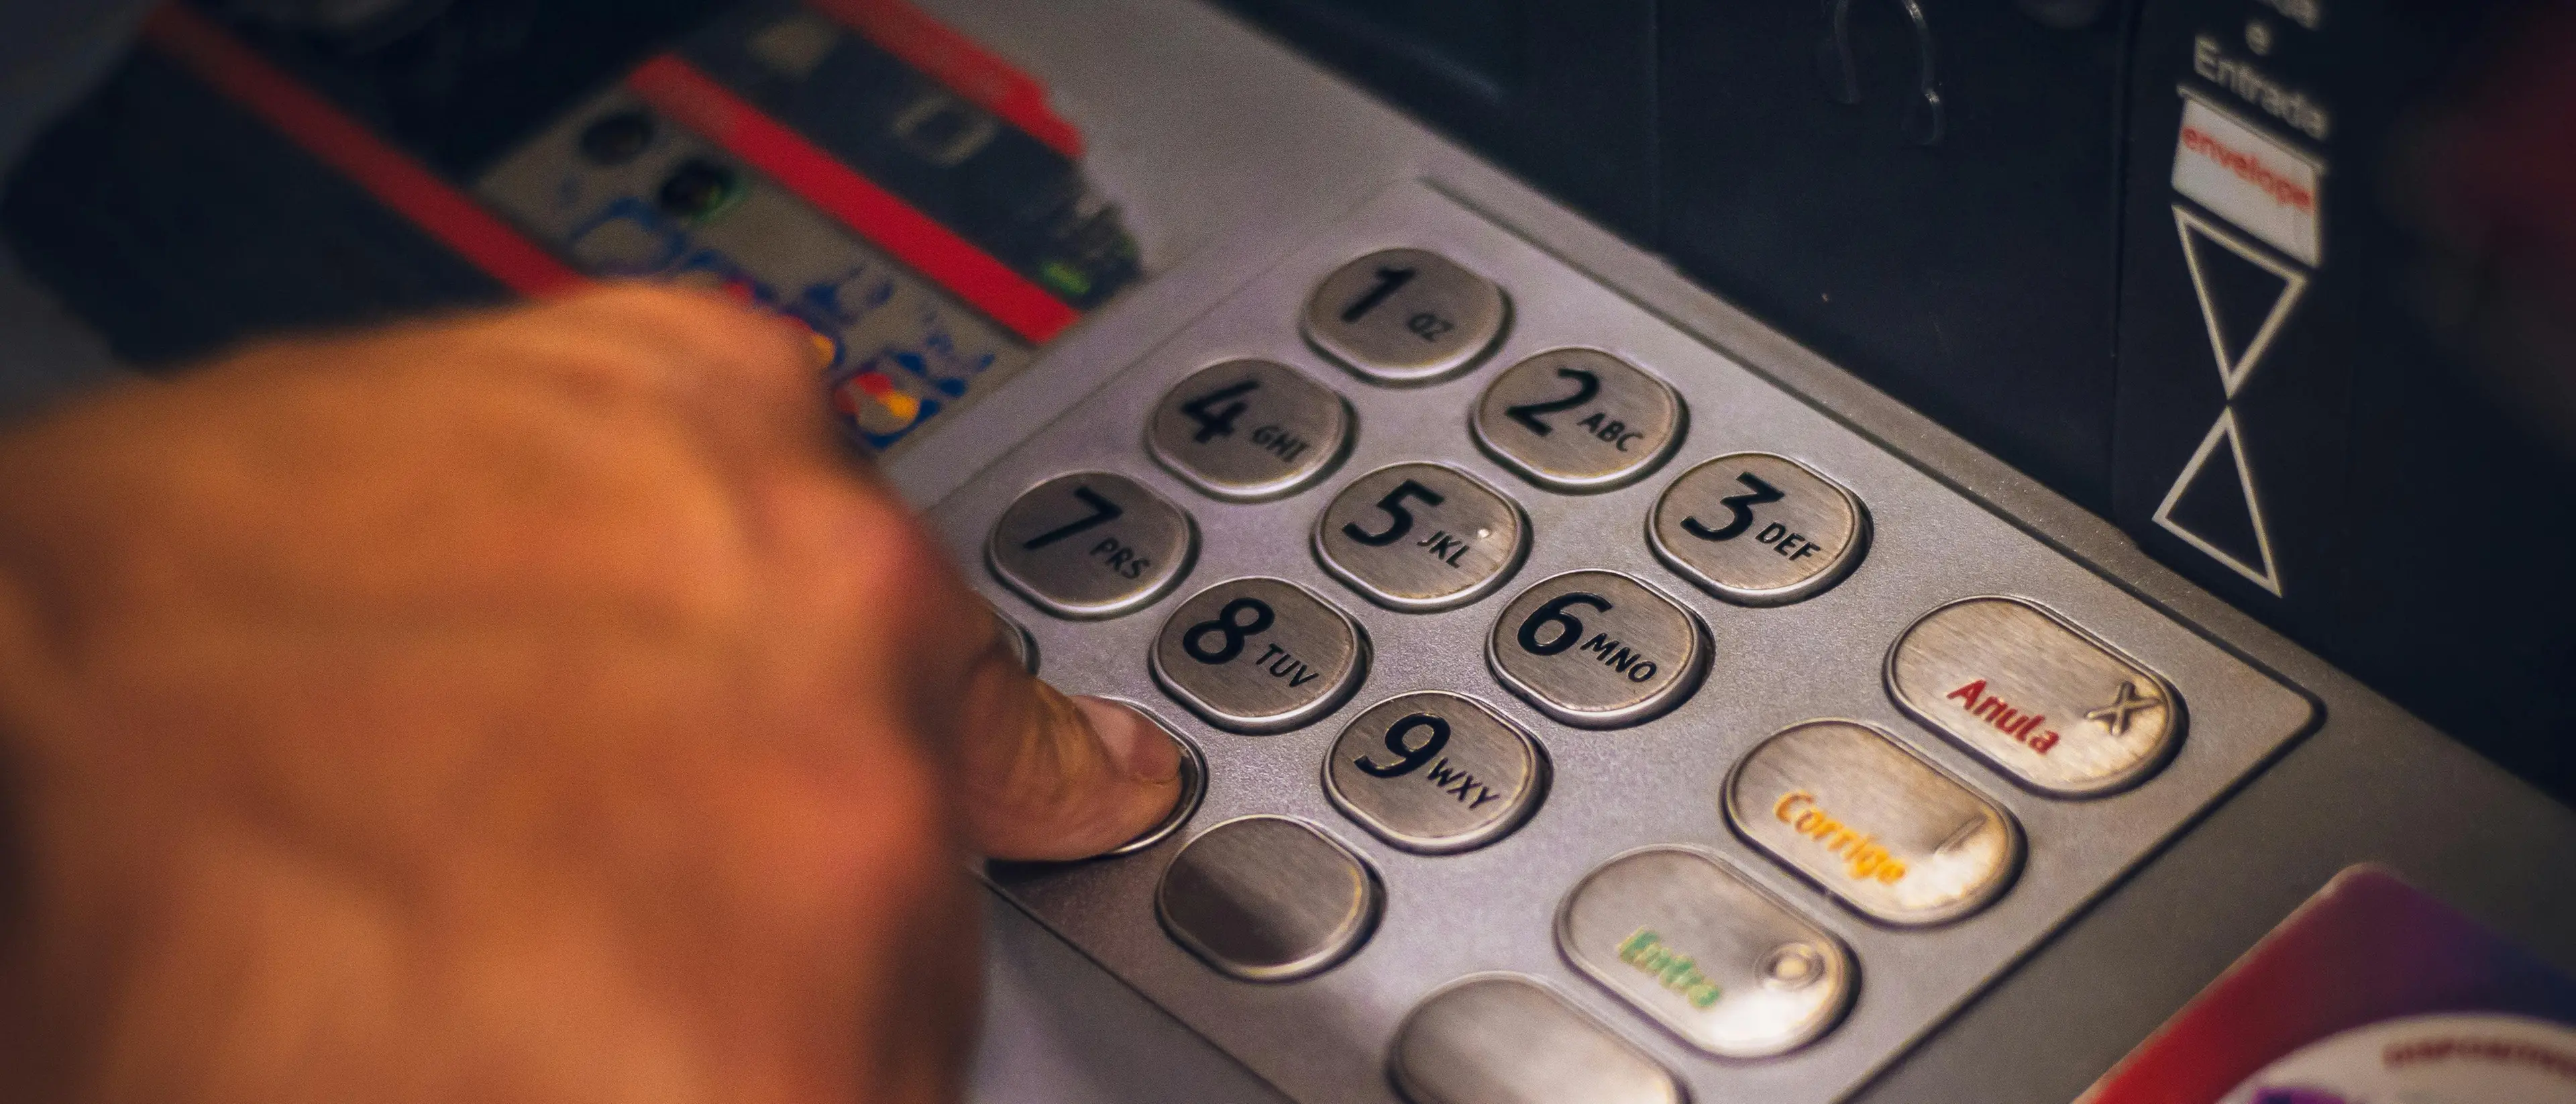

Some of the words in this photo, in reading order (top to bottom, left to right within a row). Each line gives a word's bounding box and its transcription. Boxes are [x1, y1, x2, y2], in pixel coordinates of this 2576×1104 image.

[2194, 35, 2328, 141] Entrada
[2180, 126, 2314, 215] envelope
[1341, 266, 1415, 323] 1
[1181, 379, 1260, 444] 4
[1252, 424, 1309, 463] GHI
[1505, 368, 1600, 436] 2
[1576, 411, 1644, 452] ABC
[1021, 486, 1124, 552] 7
[1090, 536, 1151, 580] PRS
[1342, 478, 1446, 547] 5
[1417, 530, 1471, 569] JKL
[1680, 471, 1785, 542] 3
[1756, 521, 1821, 561] DEF
[1182, 597, 1275, 666] 8
[1254, 643, 1320, 689] TUV
[1517, 592, 1613, 656] 6
[1580, 632, 1658, 683] MNO
[1353, 713, 1452, 780] 9
[1426, 757, 1501, 809] WXY
[1947, 679, 2059, 755] Anula
[1773, 789, 1908, 886] Corrige
[1618, 927, 1722, 1011] Entra
